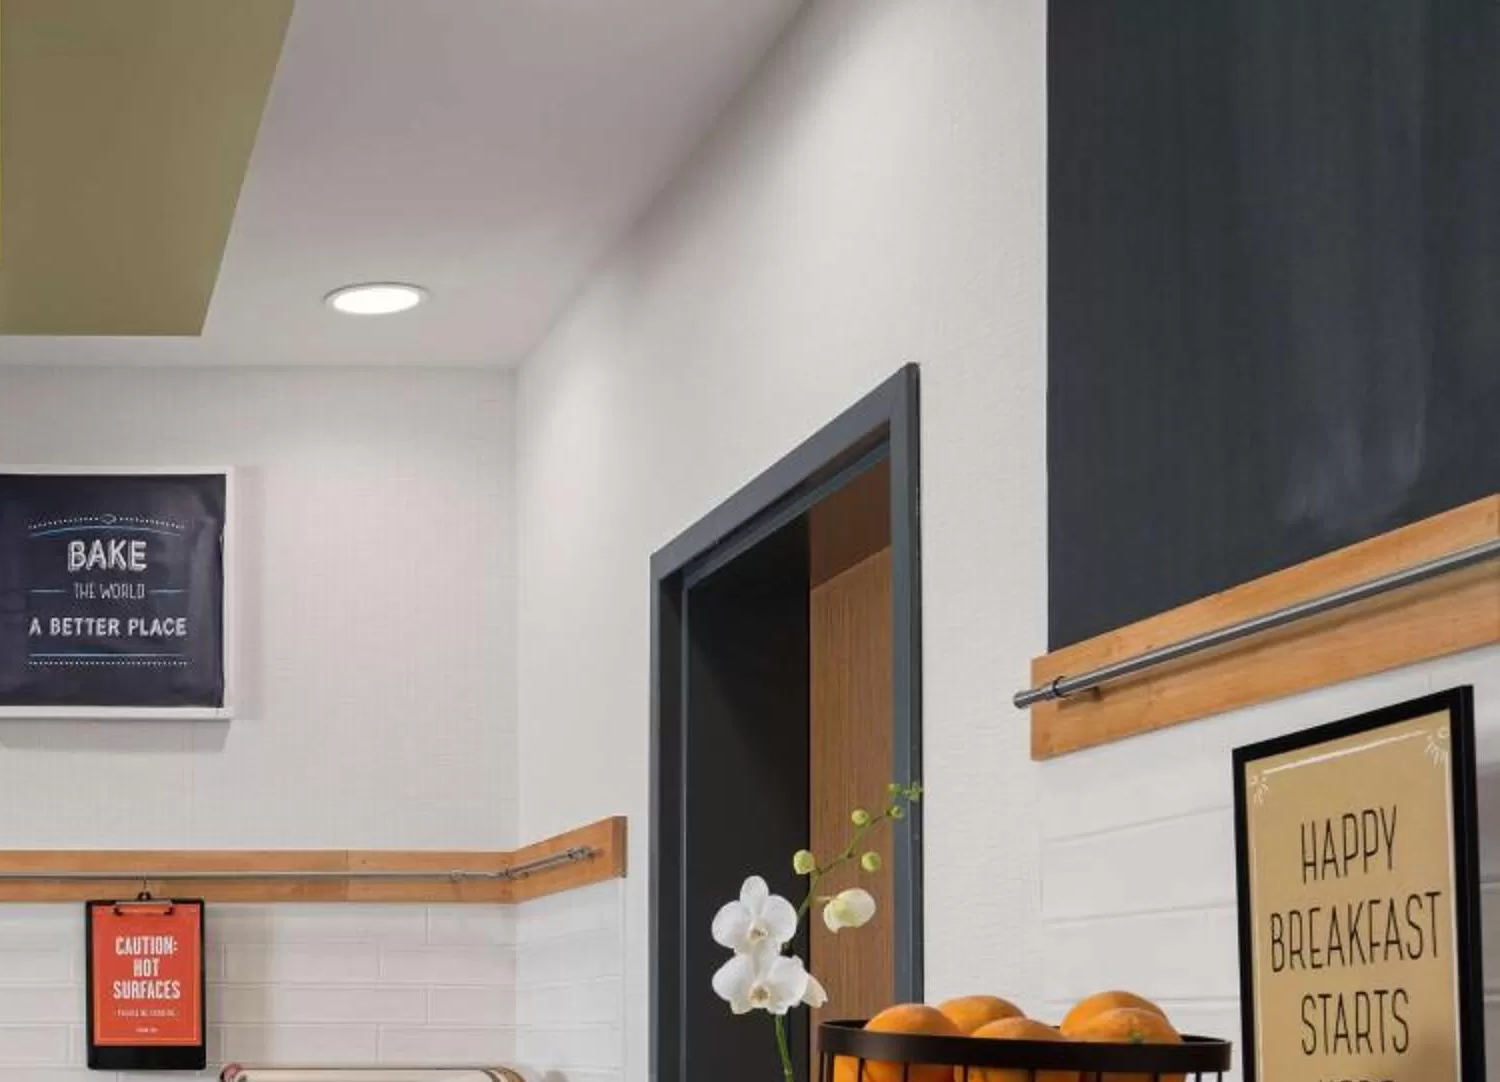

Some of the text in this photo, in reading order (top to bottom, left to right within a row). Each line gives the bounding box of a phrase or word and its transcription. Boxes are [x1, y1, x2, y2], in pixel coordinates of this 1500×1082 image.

[67, 539, 148, 572] BAKE
[73, 582, 145, 600] THE WORLD
[28, 617, 188, 637] A BETTER PLACE
[1301, 804, 1398, 885] HAPPY
[1270, 891, 1443, 974] BREAKFAST
[115, 935, 179, 955] CAUTION:
[133, 957, 160, 977] HOT
[113, 980, 181, 1000] SURFACES
[1301, 987, 1411, 1057] STARTS
